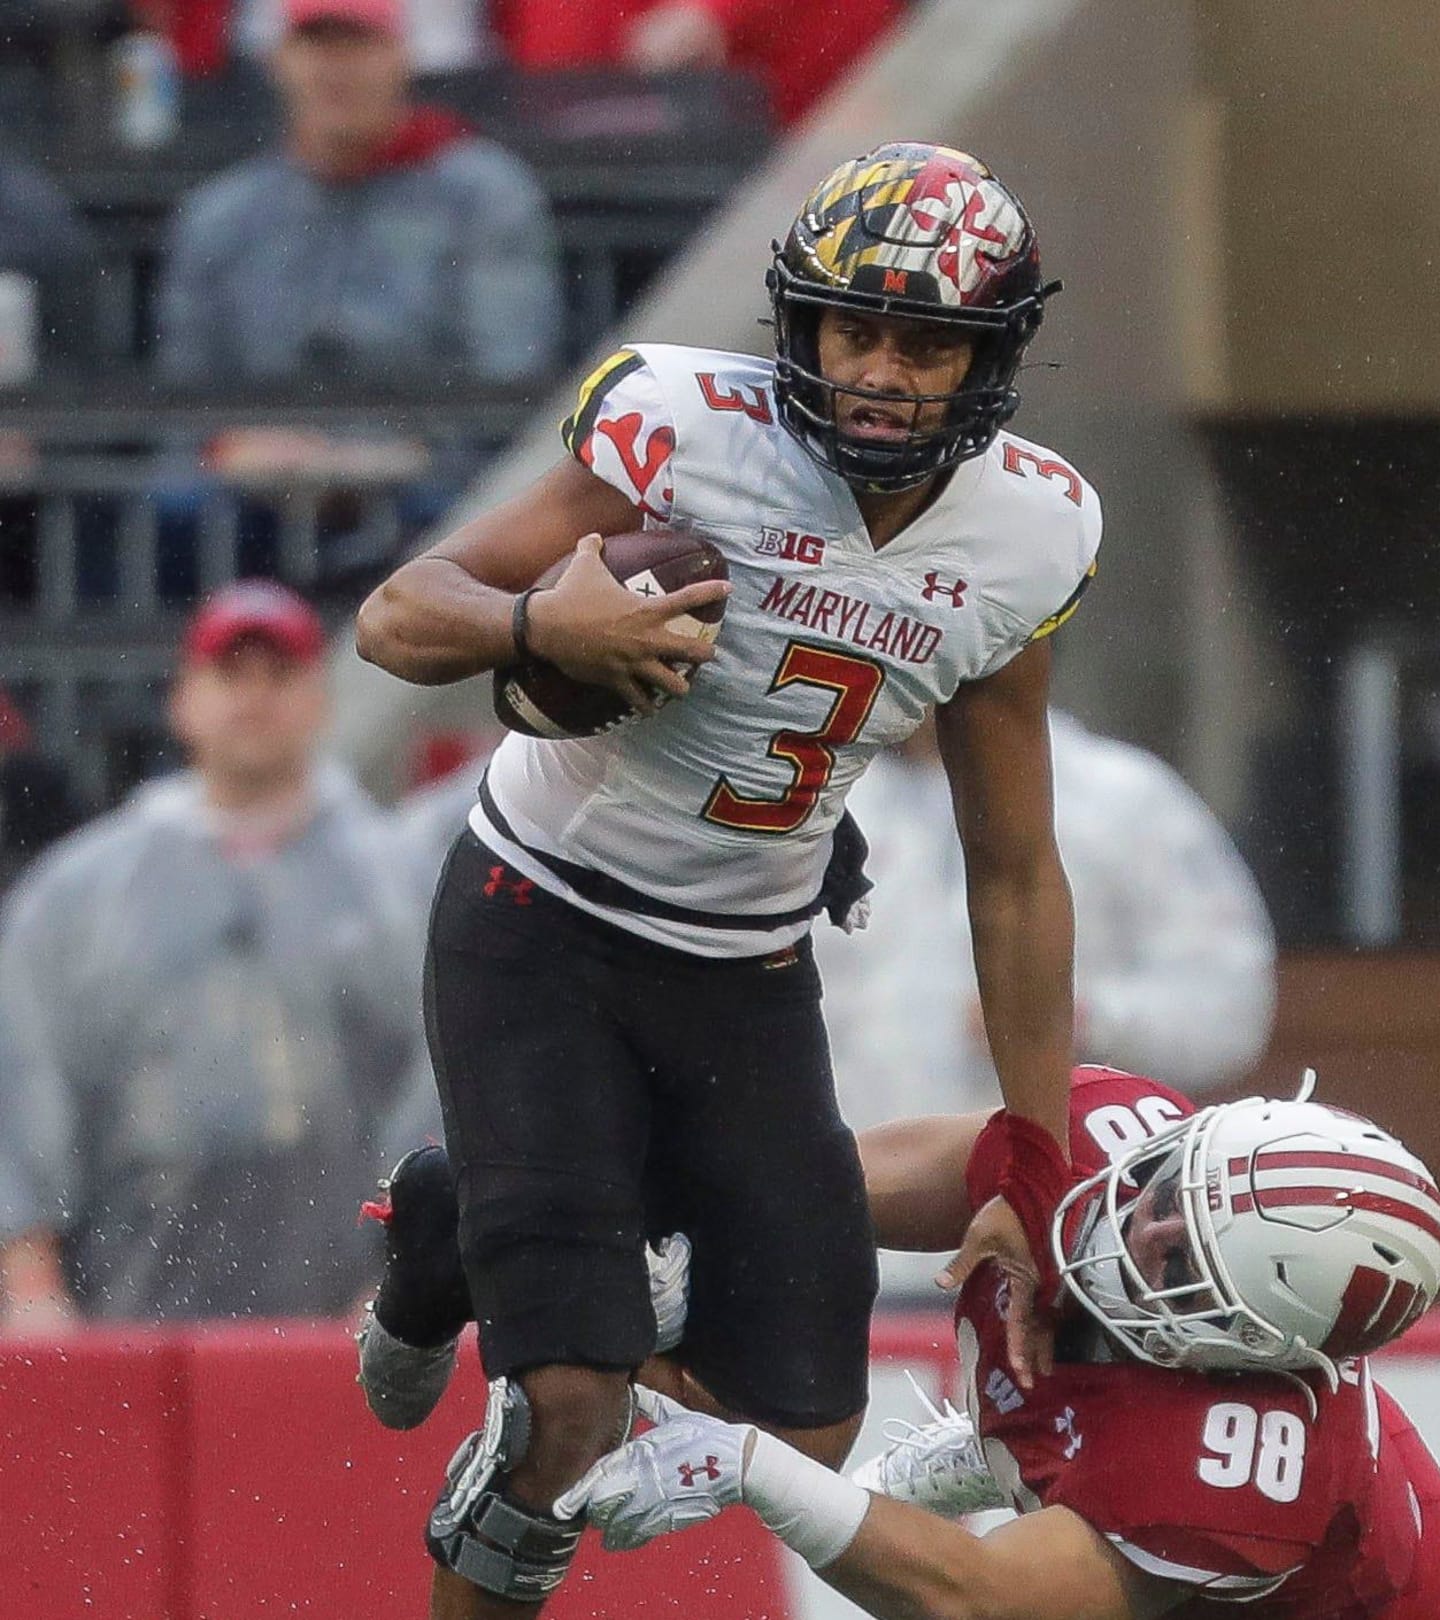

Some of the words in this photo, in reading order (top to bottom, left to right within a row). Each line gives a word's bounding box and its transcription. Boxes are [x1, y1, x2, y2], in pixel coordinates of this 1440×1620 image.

[1002, 441, 1083, 508] 3
[760, 576, 943, 664] MARYLAND
[701, 639, 886, 834] 3
[1199, 1402, 1305, 1503] 98
